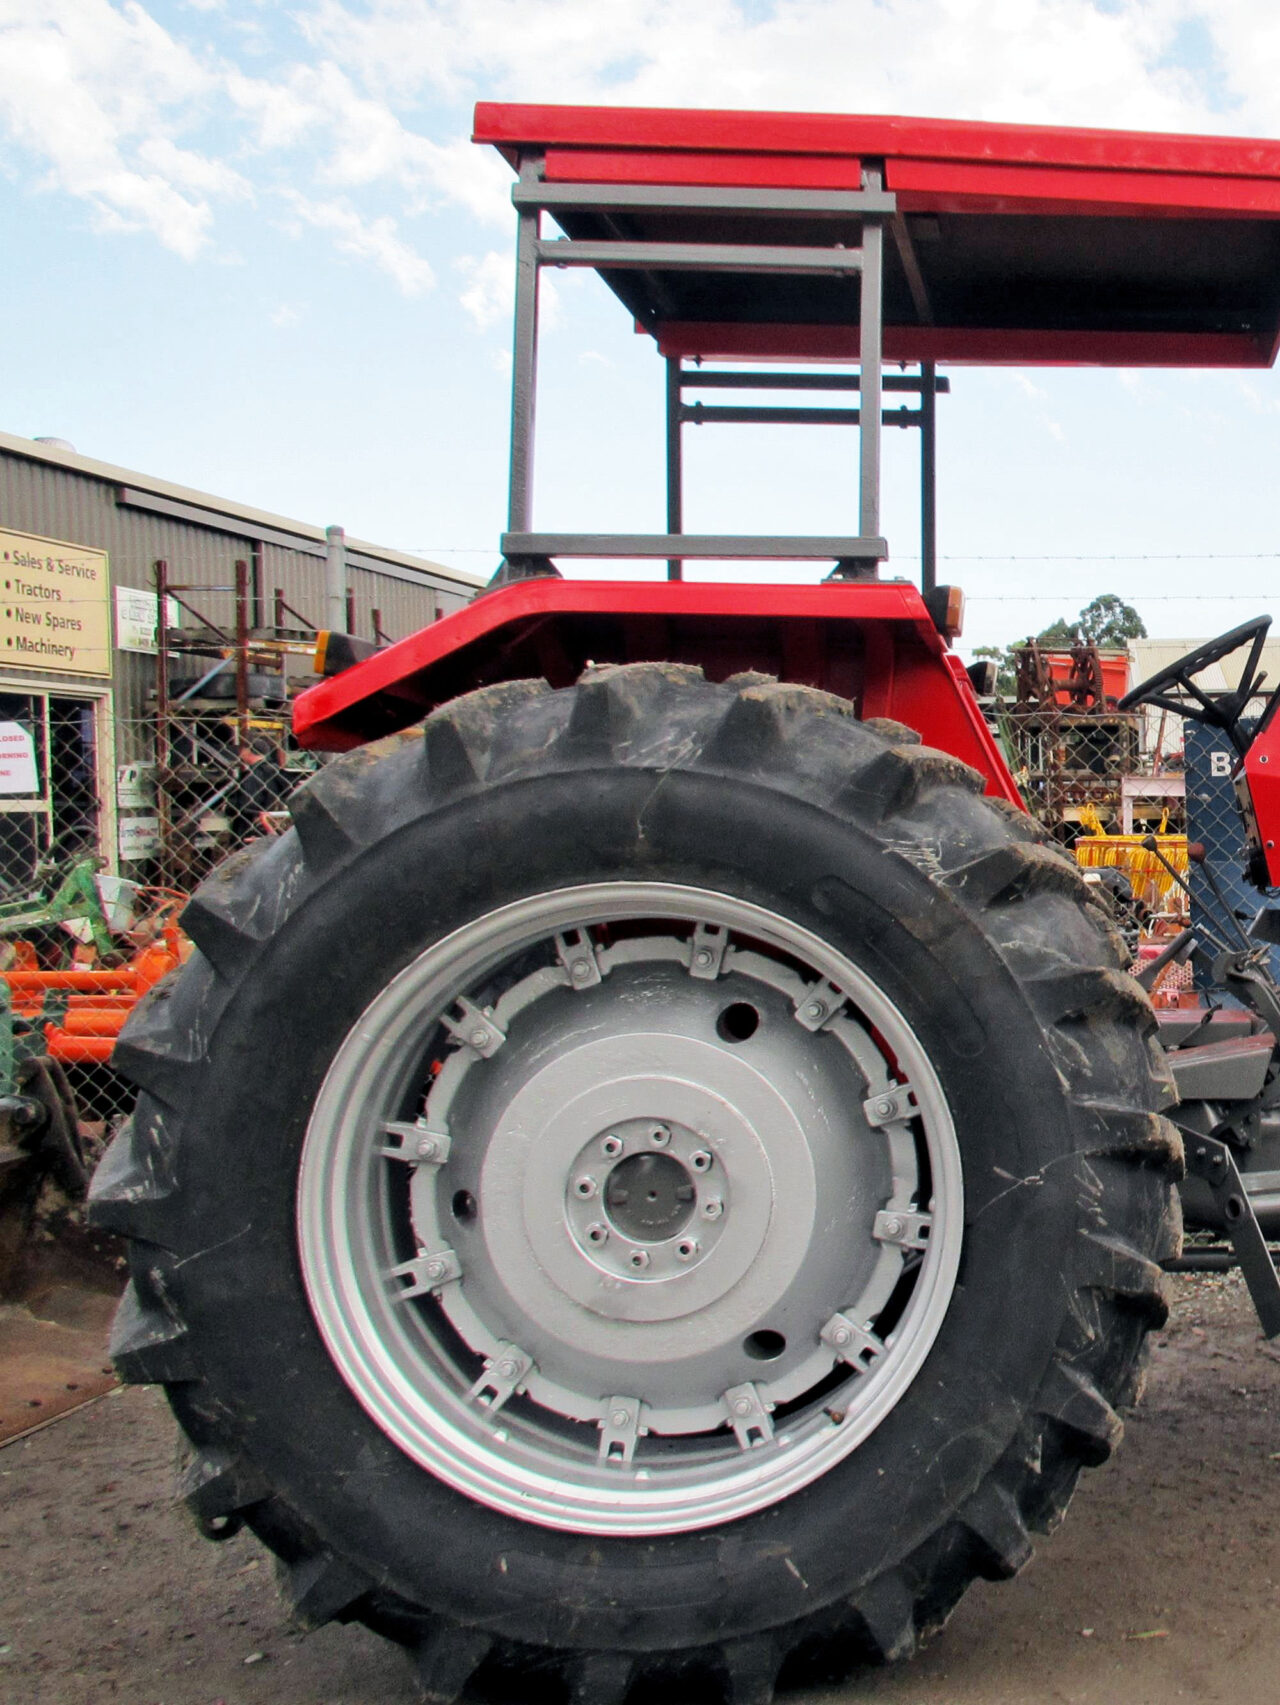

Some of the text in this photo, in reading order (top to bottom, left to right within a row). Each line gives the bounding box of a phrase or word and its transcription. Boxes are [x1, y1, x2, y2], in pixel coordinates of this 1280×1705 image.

[13, 550, 97, 580] Sales & Service
[15, 578, 62, 601] Tractors
[15, 607, 82, 631] New Spares
[15, 635, 76, 661] Machinery
[1210, 751, 1239, 777] B
